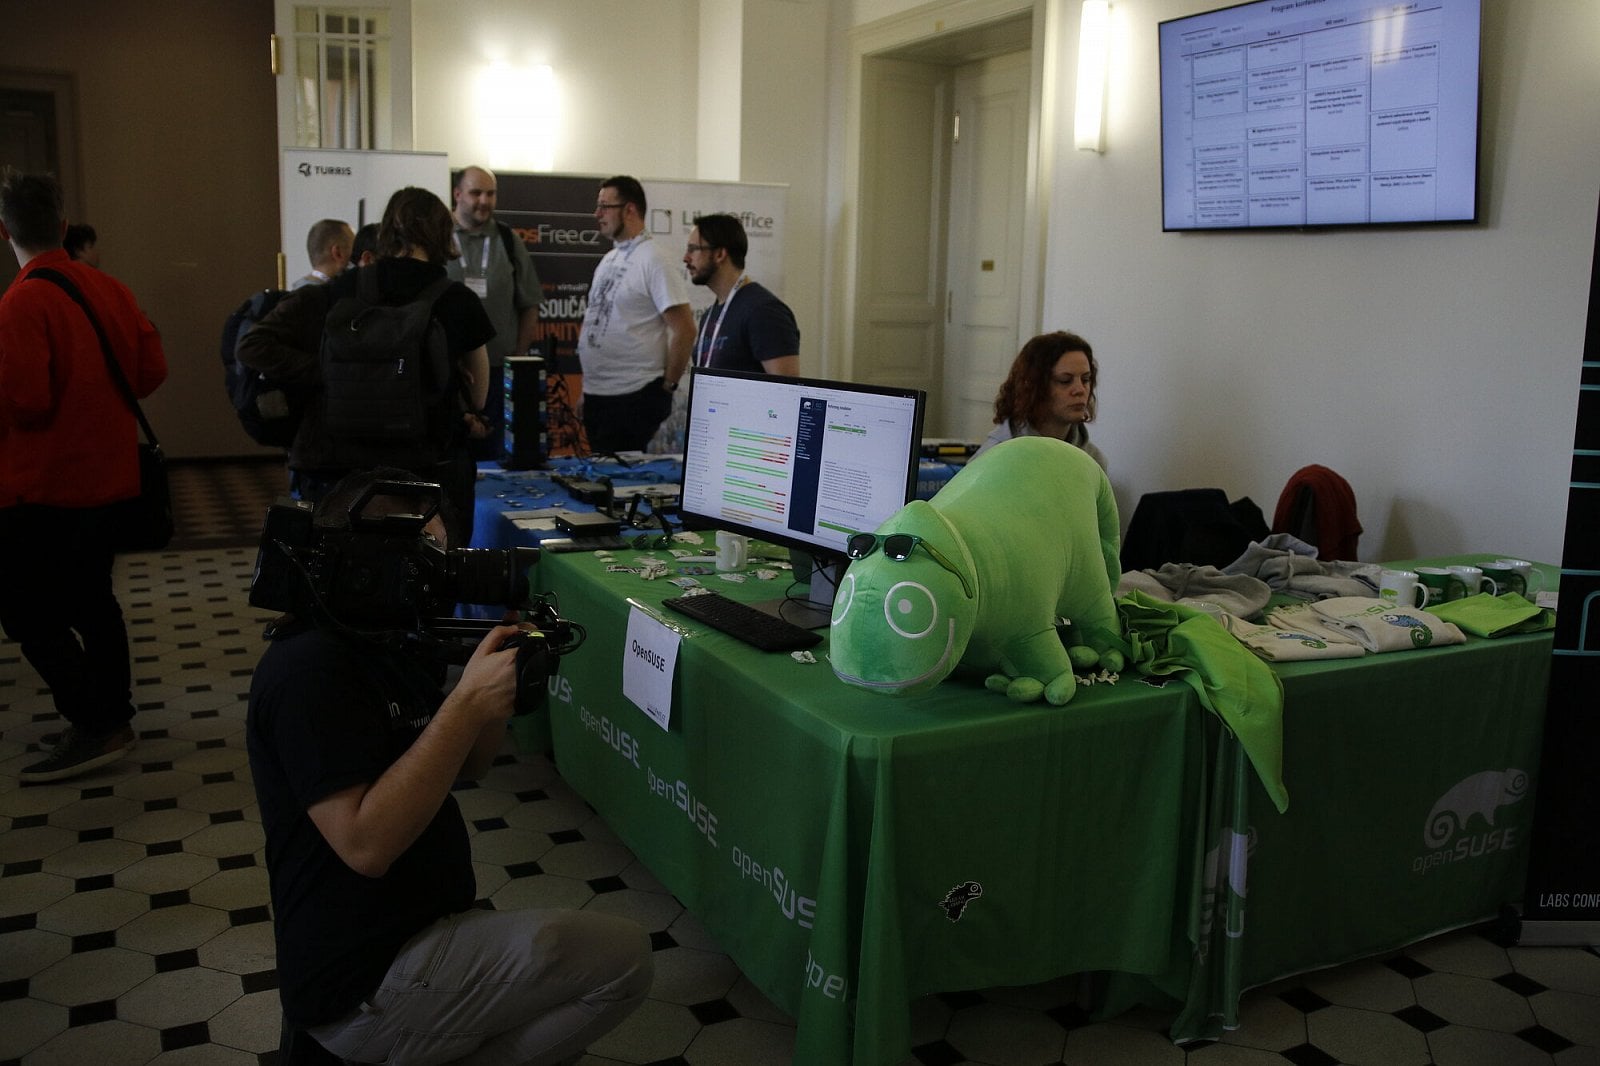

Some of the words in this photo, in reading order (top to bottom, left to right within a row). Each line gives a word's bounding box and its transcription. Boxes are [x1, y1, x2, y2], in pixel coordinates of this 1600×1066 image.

[315, 165, 352, 176] TURRIS
[632, 639, 665, 672] OpenSUSE
[580, 705, 640, 769] openSUSE
[1412, 827, 1517, 875] openSUSE
[1539, 893, 1570, 908] LABS
